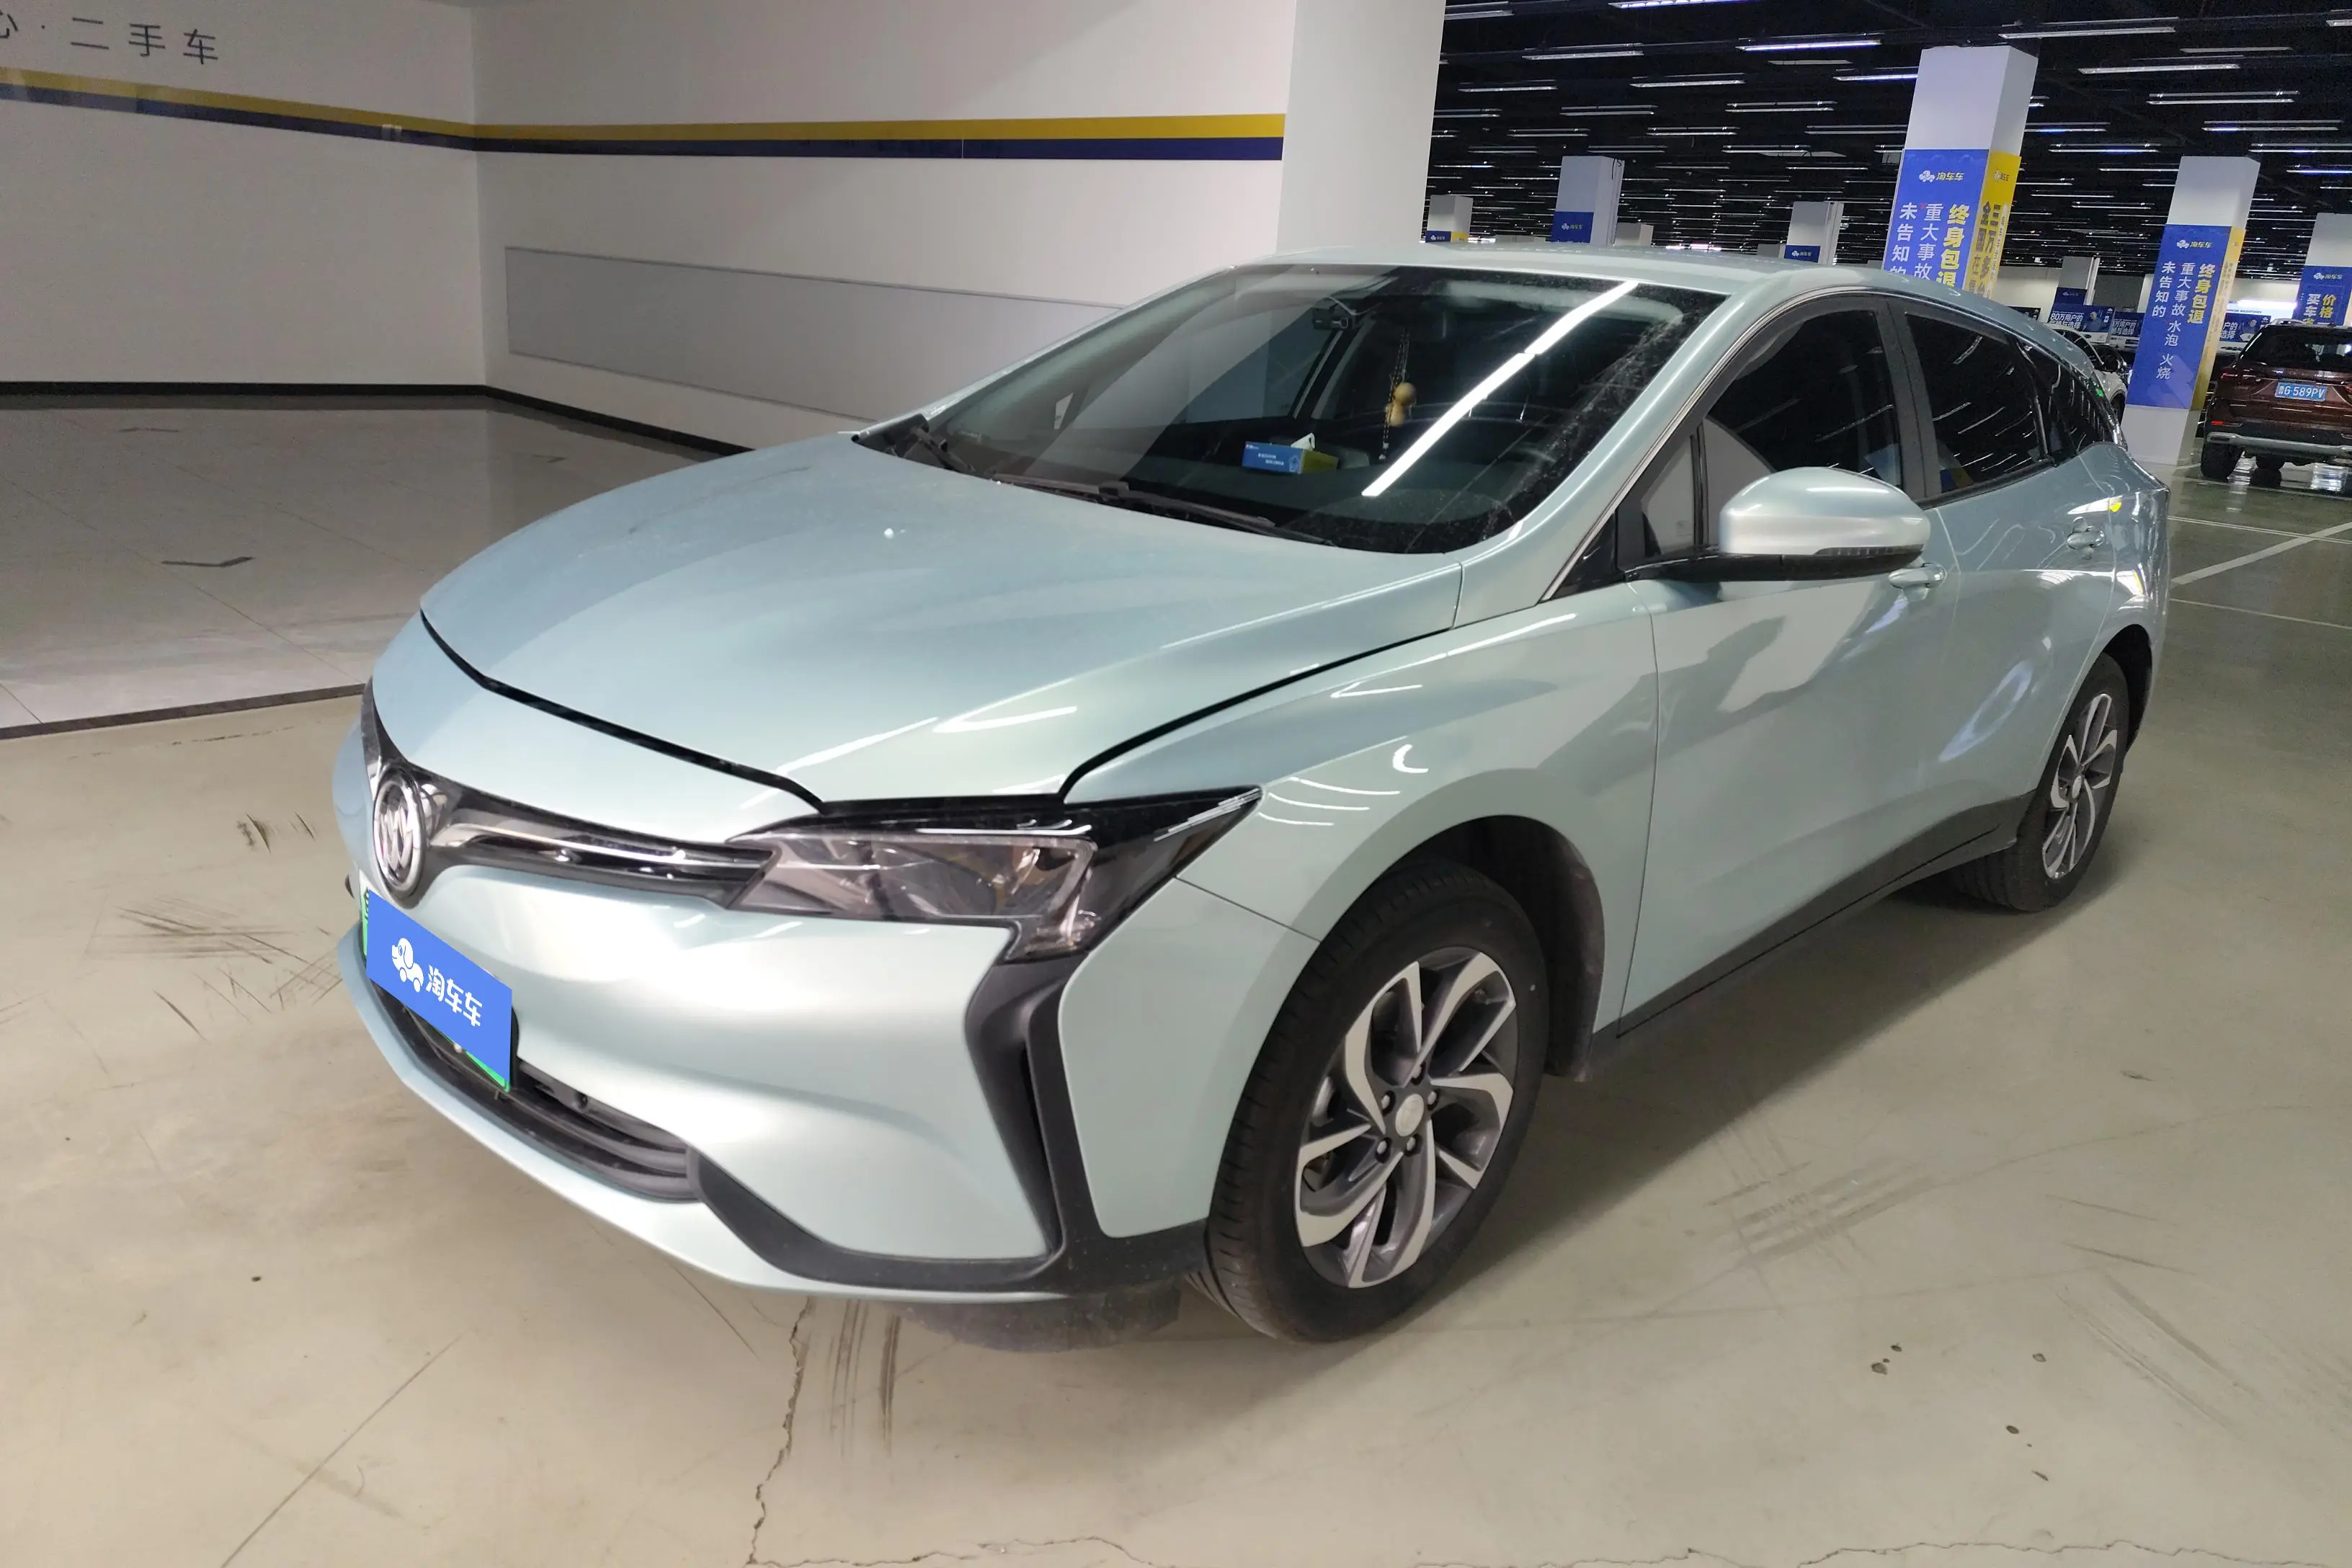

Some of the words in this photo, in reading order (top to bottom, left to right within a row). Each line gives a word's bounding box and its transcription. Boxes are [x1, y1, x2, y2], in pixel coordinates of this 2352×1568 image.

[1936, 172, 1964, 181] 淘车车
[1914, 203, 1943, 280] 重大事故
[1936, 203, 1970, 288] 终身包退
[2152, 261, 2176, 318] 未告知的
[2171, 262, 2196, 316] 重大事故
[2187, 263, 2216, 324] 终身包退
[2320, 294, 2337, 318] 价格
[2050, 313, 2083, 322] 80万用户的
[2165, 321, 2181, 347] 水泡
[2155, 353, 2174, 380] 火烧
